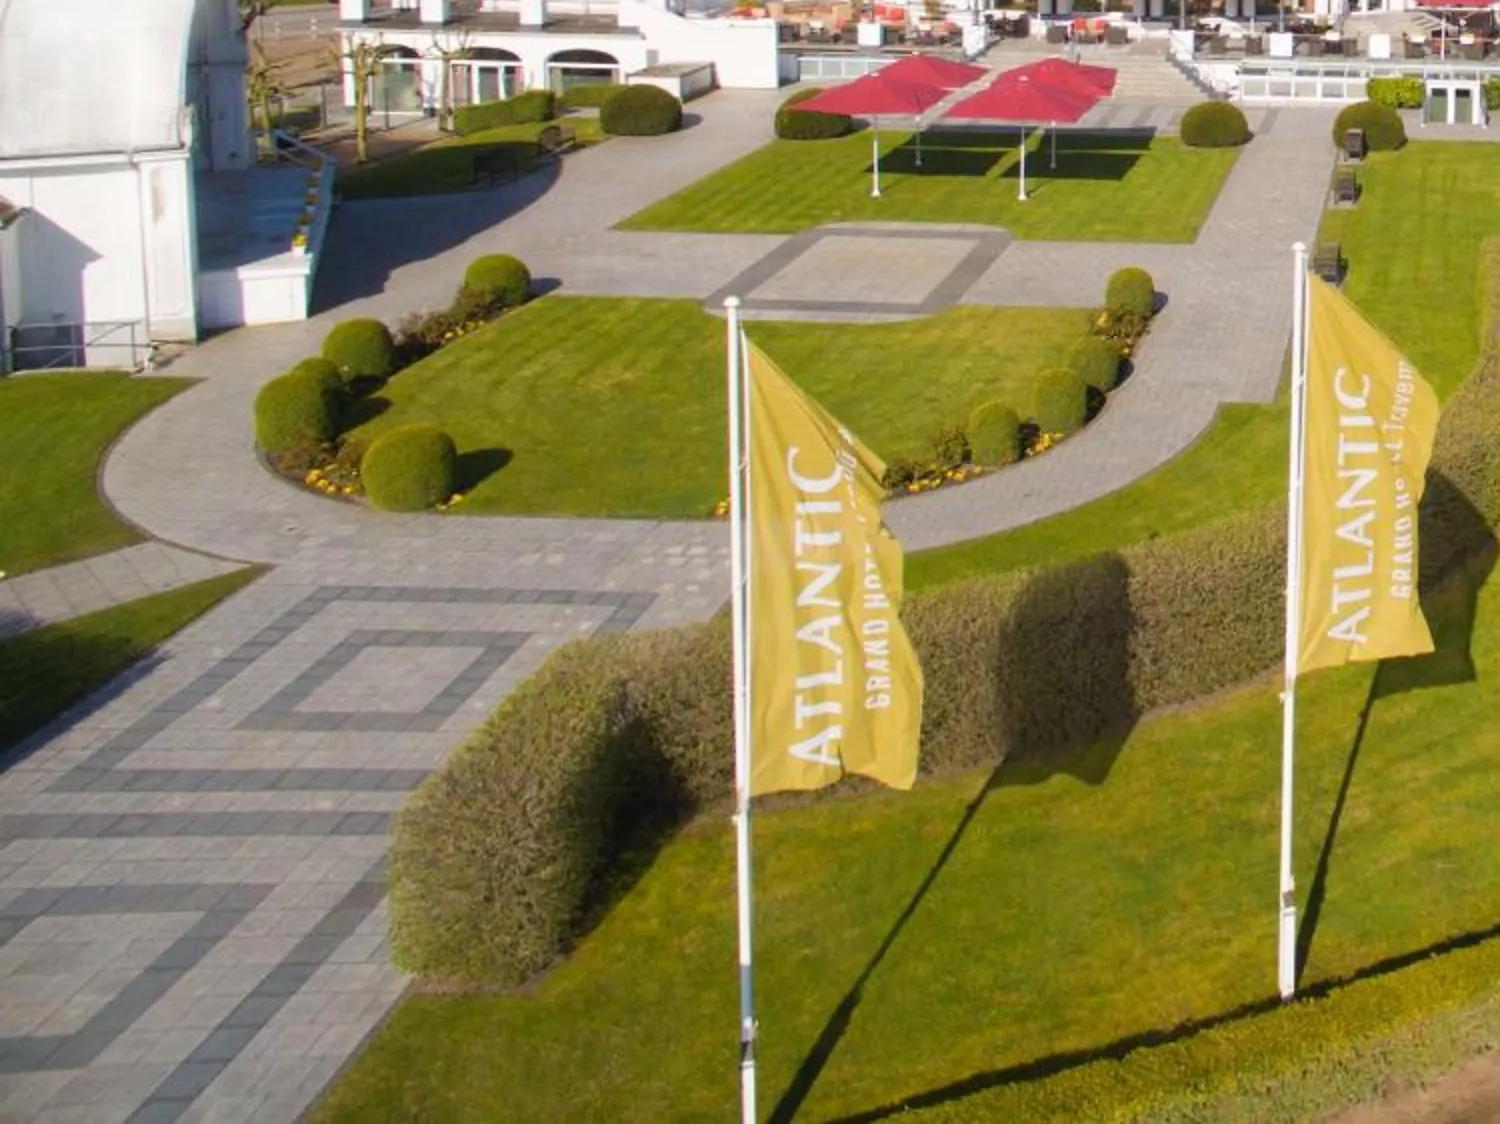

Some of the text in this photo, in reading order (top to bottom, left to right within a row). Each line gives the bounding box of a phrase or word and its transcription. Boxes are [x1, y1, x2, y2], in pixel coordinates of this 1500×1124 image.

[1328, 368, 1378, 644] ATLANTIC
[1389, 514, 1413, 599] GRAND
[787, 446, 844, 766] ATLANTIC
[864, 619, 892, 710] GRAND
